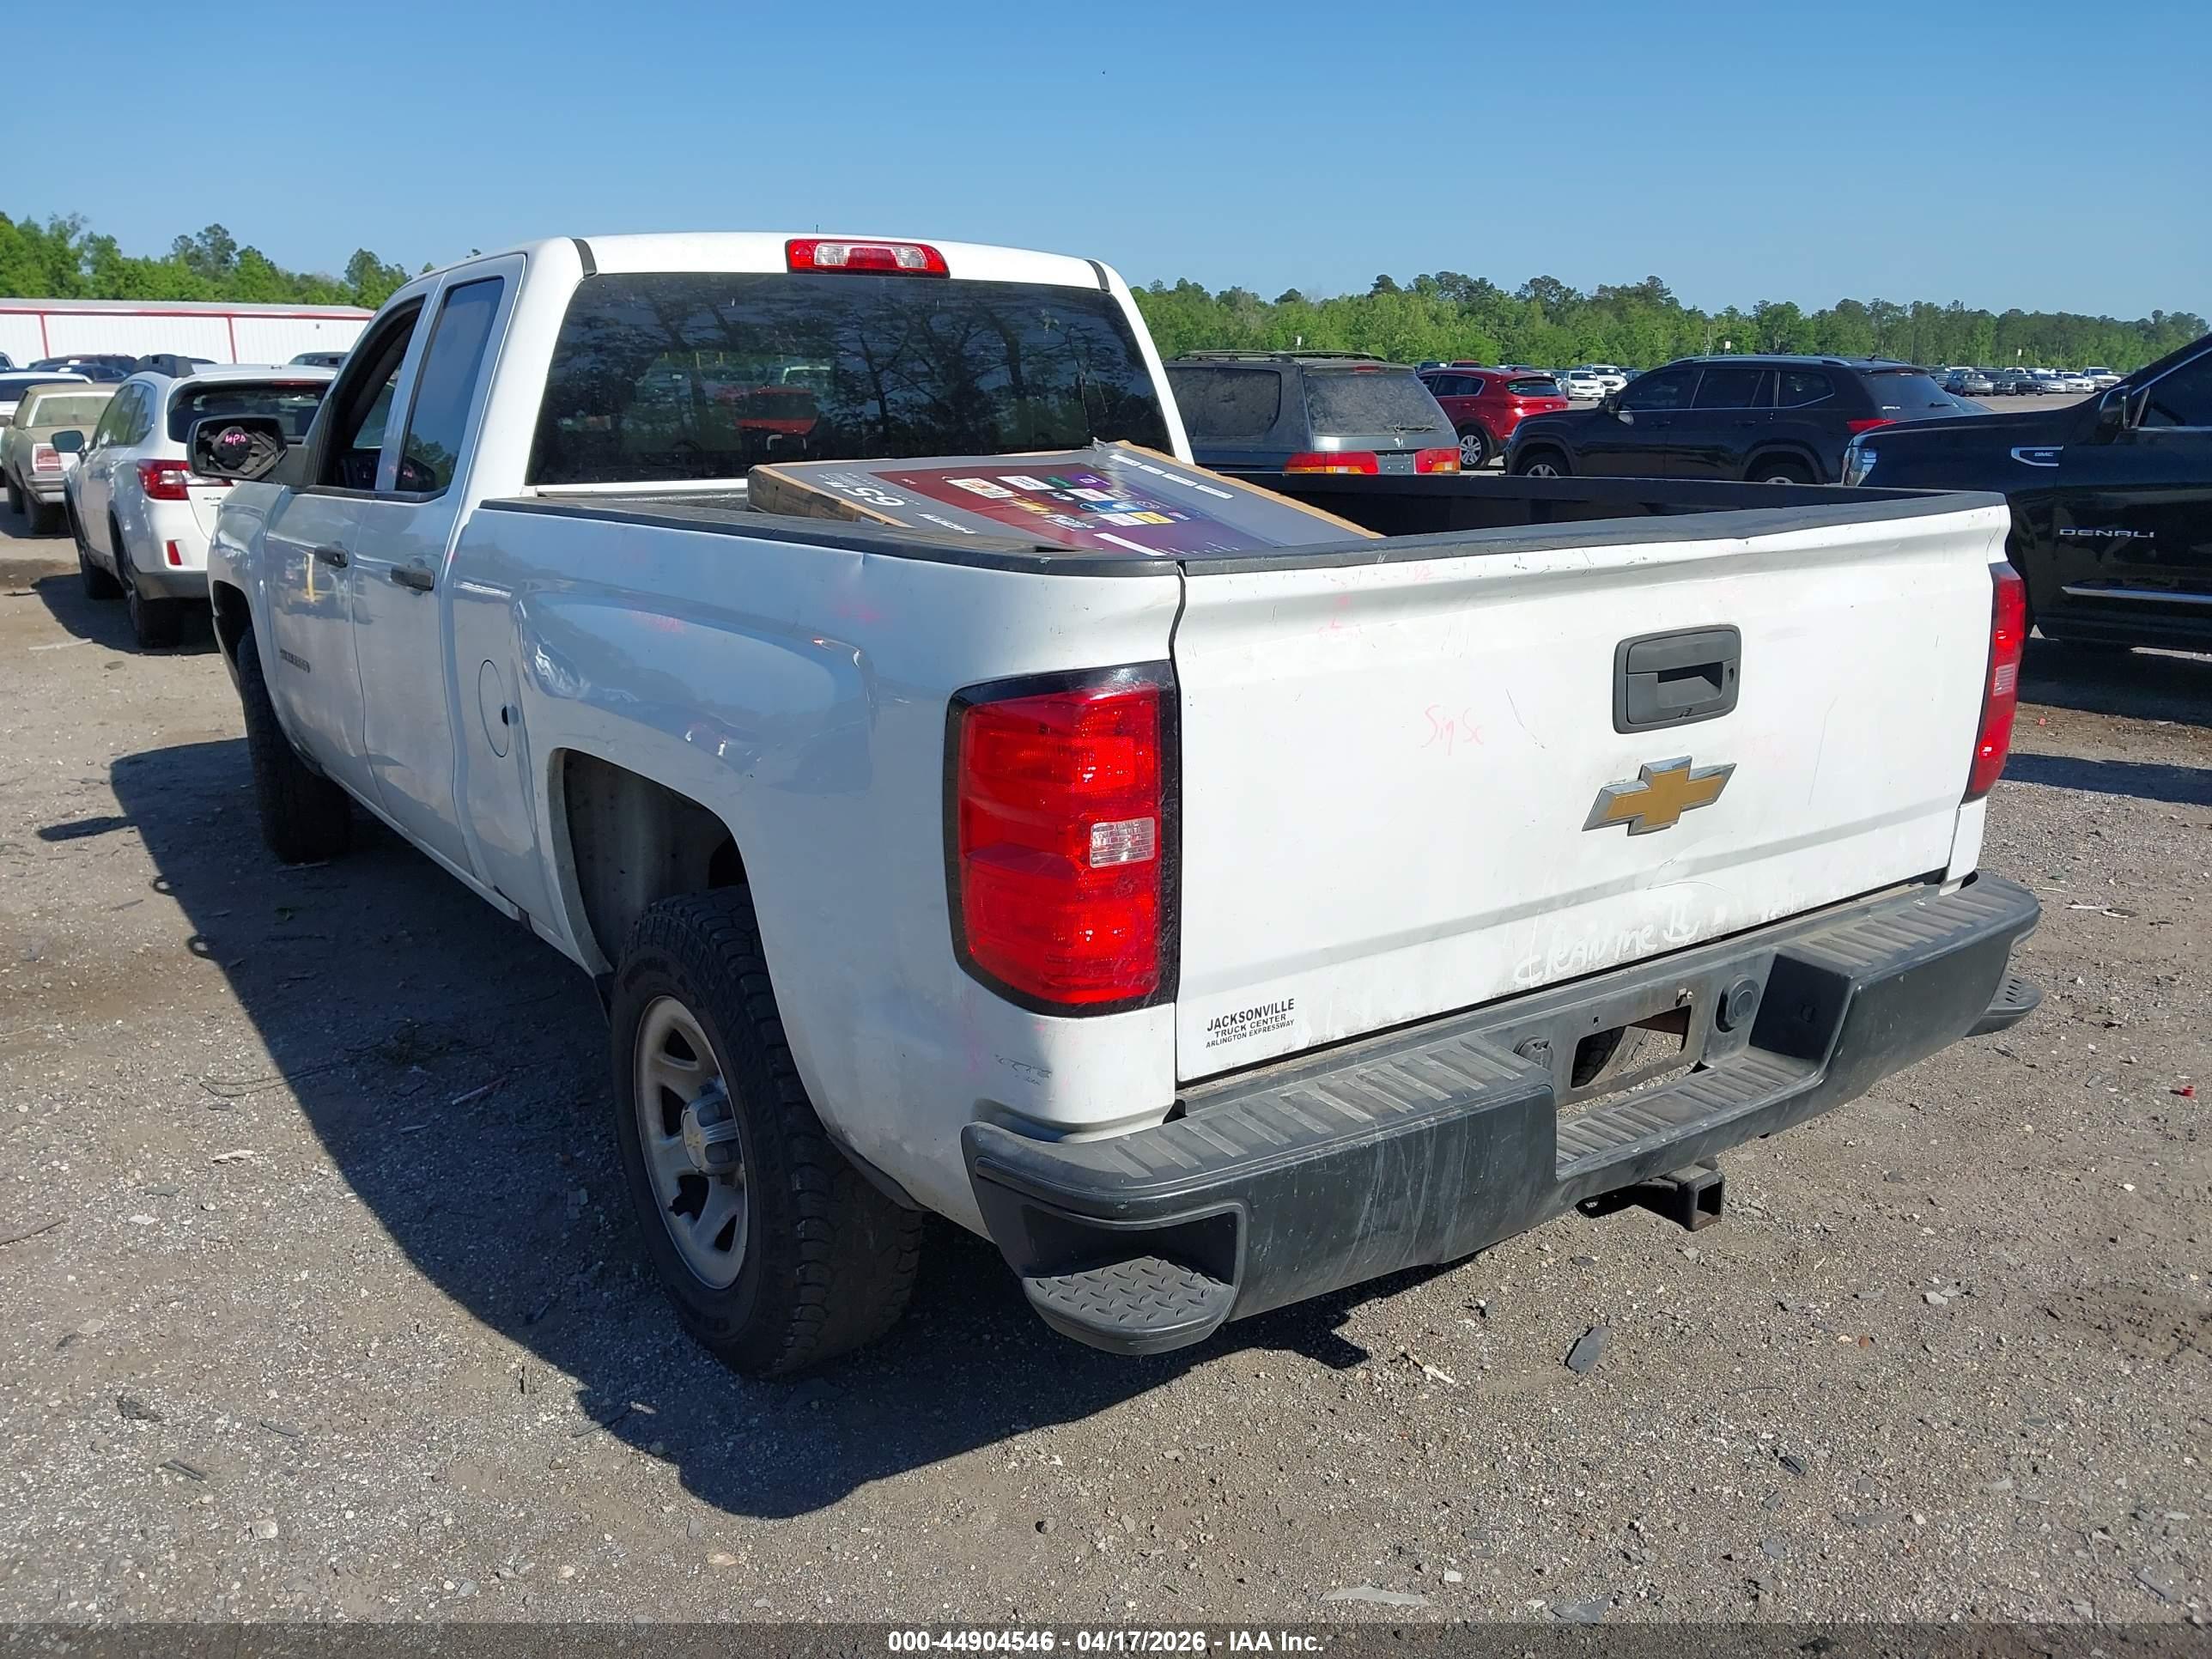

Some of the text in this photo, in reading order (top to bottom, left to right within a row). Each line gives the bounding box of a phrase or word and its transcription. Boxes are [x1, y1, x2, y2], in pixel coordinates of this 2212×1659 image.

[2059, 528, 2155, 538] DENALI
[1206, 998, 1295, 1032] JACKSONVILLE
[1214, 1013, 1287, 1038] TRUCK CENTER
[1206, 1018, 1295, 1048] ARLINGTON EXPRESSWAY
